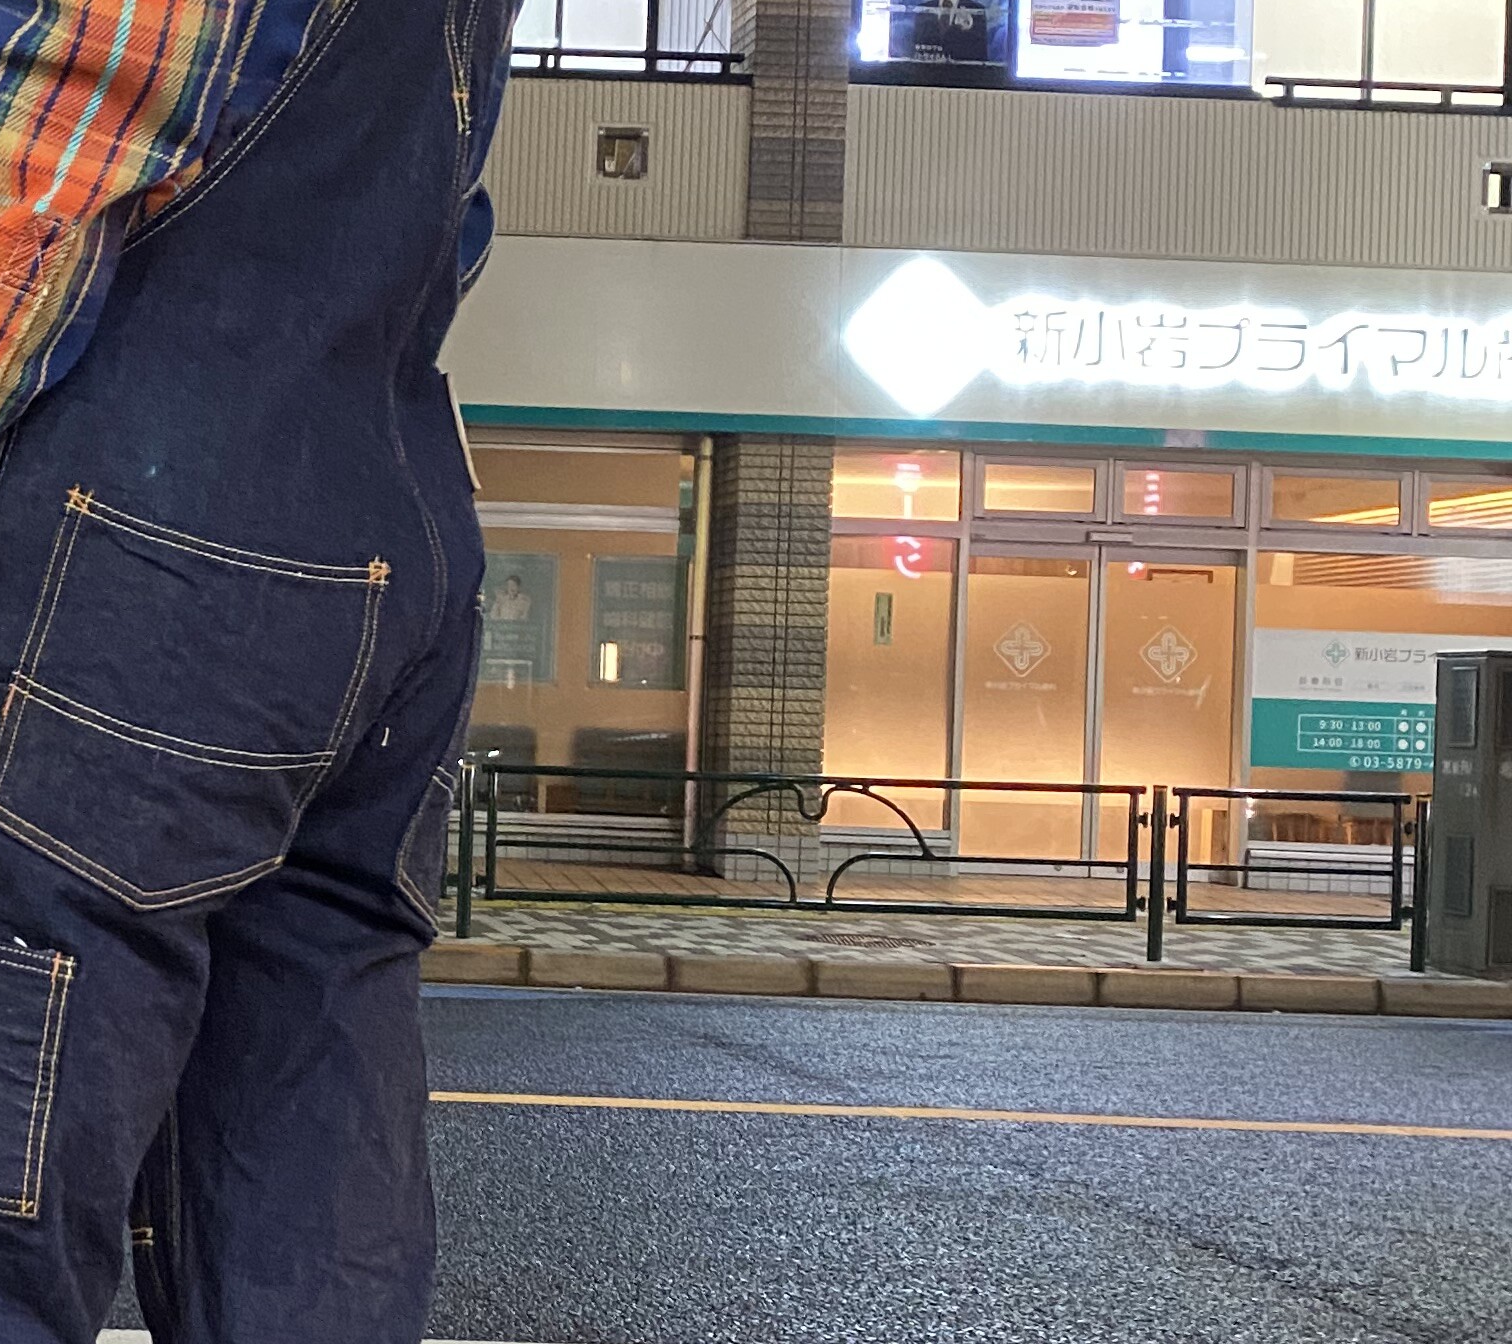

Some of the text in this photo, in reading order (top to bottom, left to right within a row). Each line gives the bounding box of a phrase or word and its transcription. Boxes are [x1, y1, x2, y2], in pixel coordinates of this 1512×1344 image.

[1014, 310, 1512, 379] 新小岩プライマル
